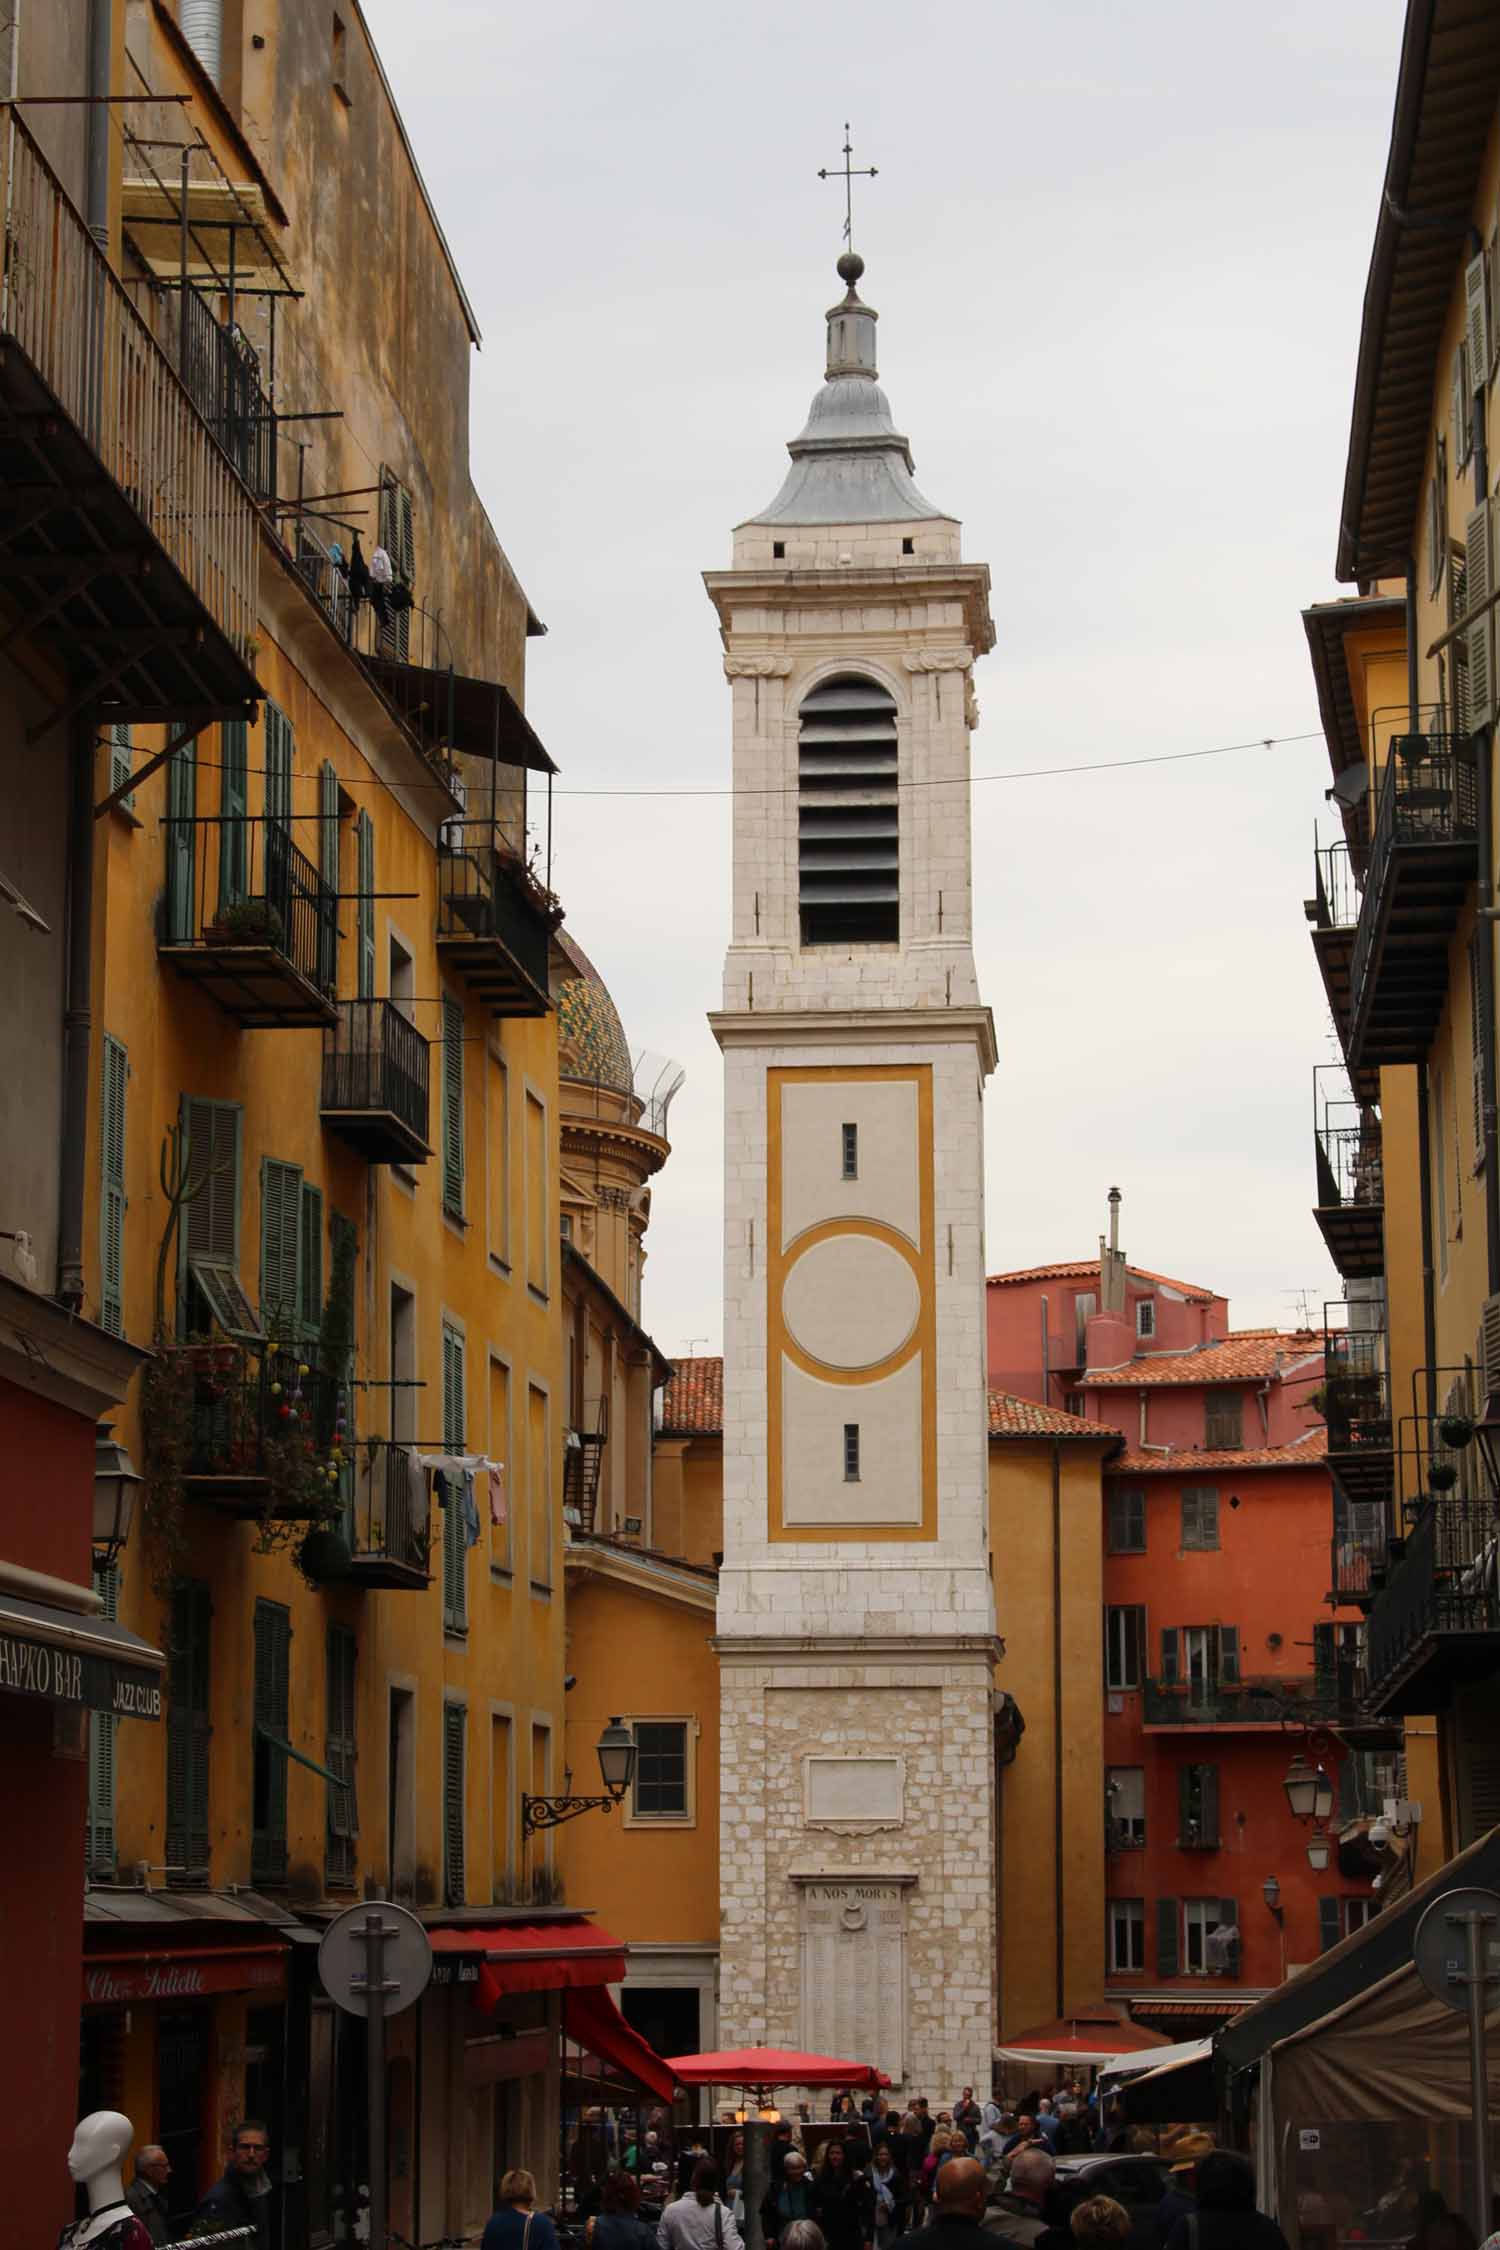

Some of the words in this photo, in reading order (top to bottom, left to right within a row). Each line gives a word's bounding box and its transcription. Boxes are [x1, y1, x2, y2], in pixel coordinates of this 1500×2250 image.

[54, 1650, 82, 1701] BAR
[113, 1680, 135, 1711] JAZZ
[136, 1687, 161, 1715] CLUB
[823, 1887, 849, 1899] NOS
